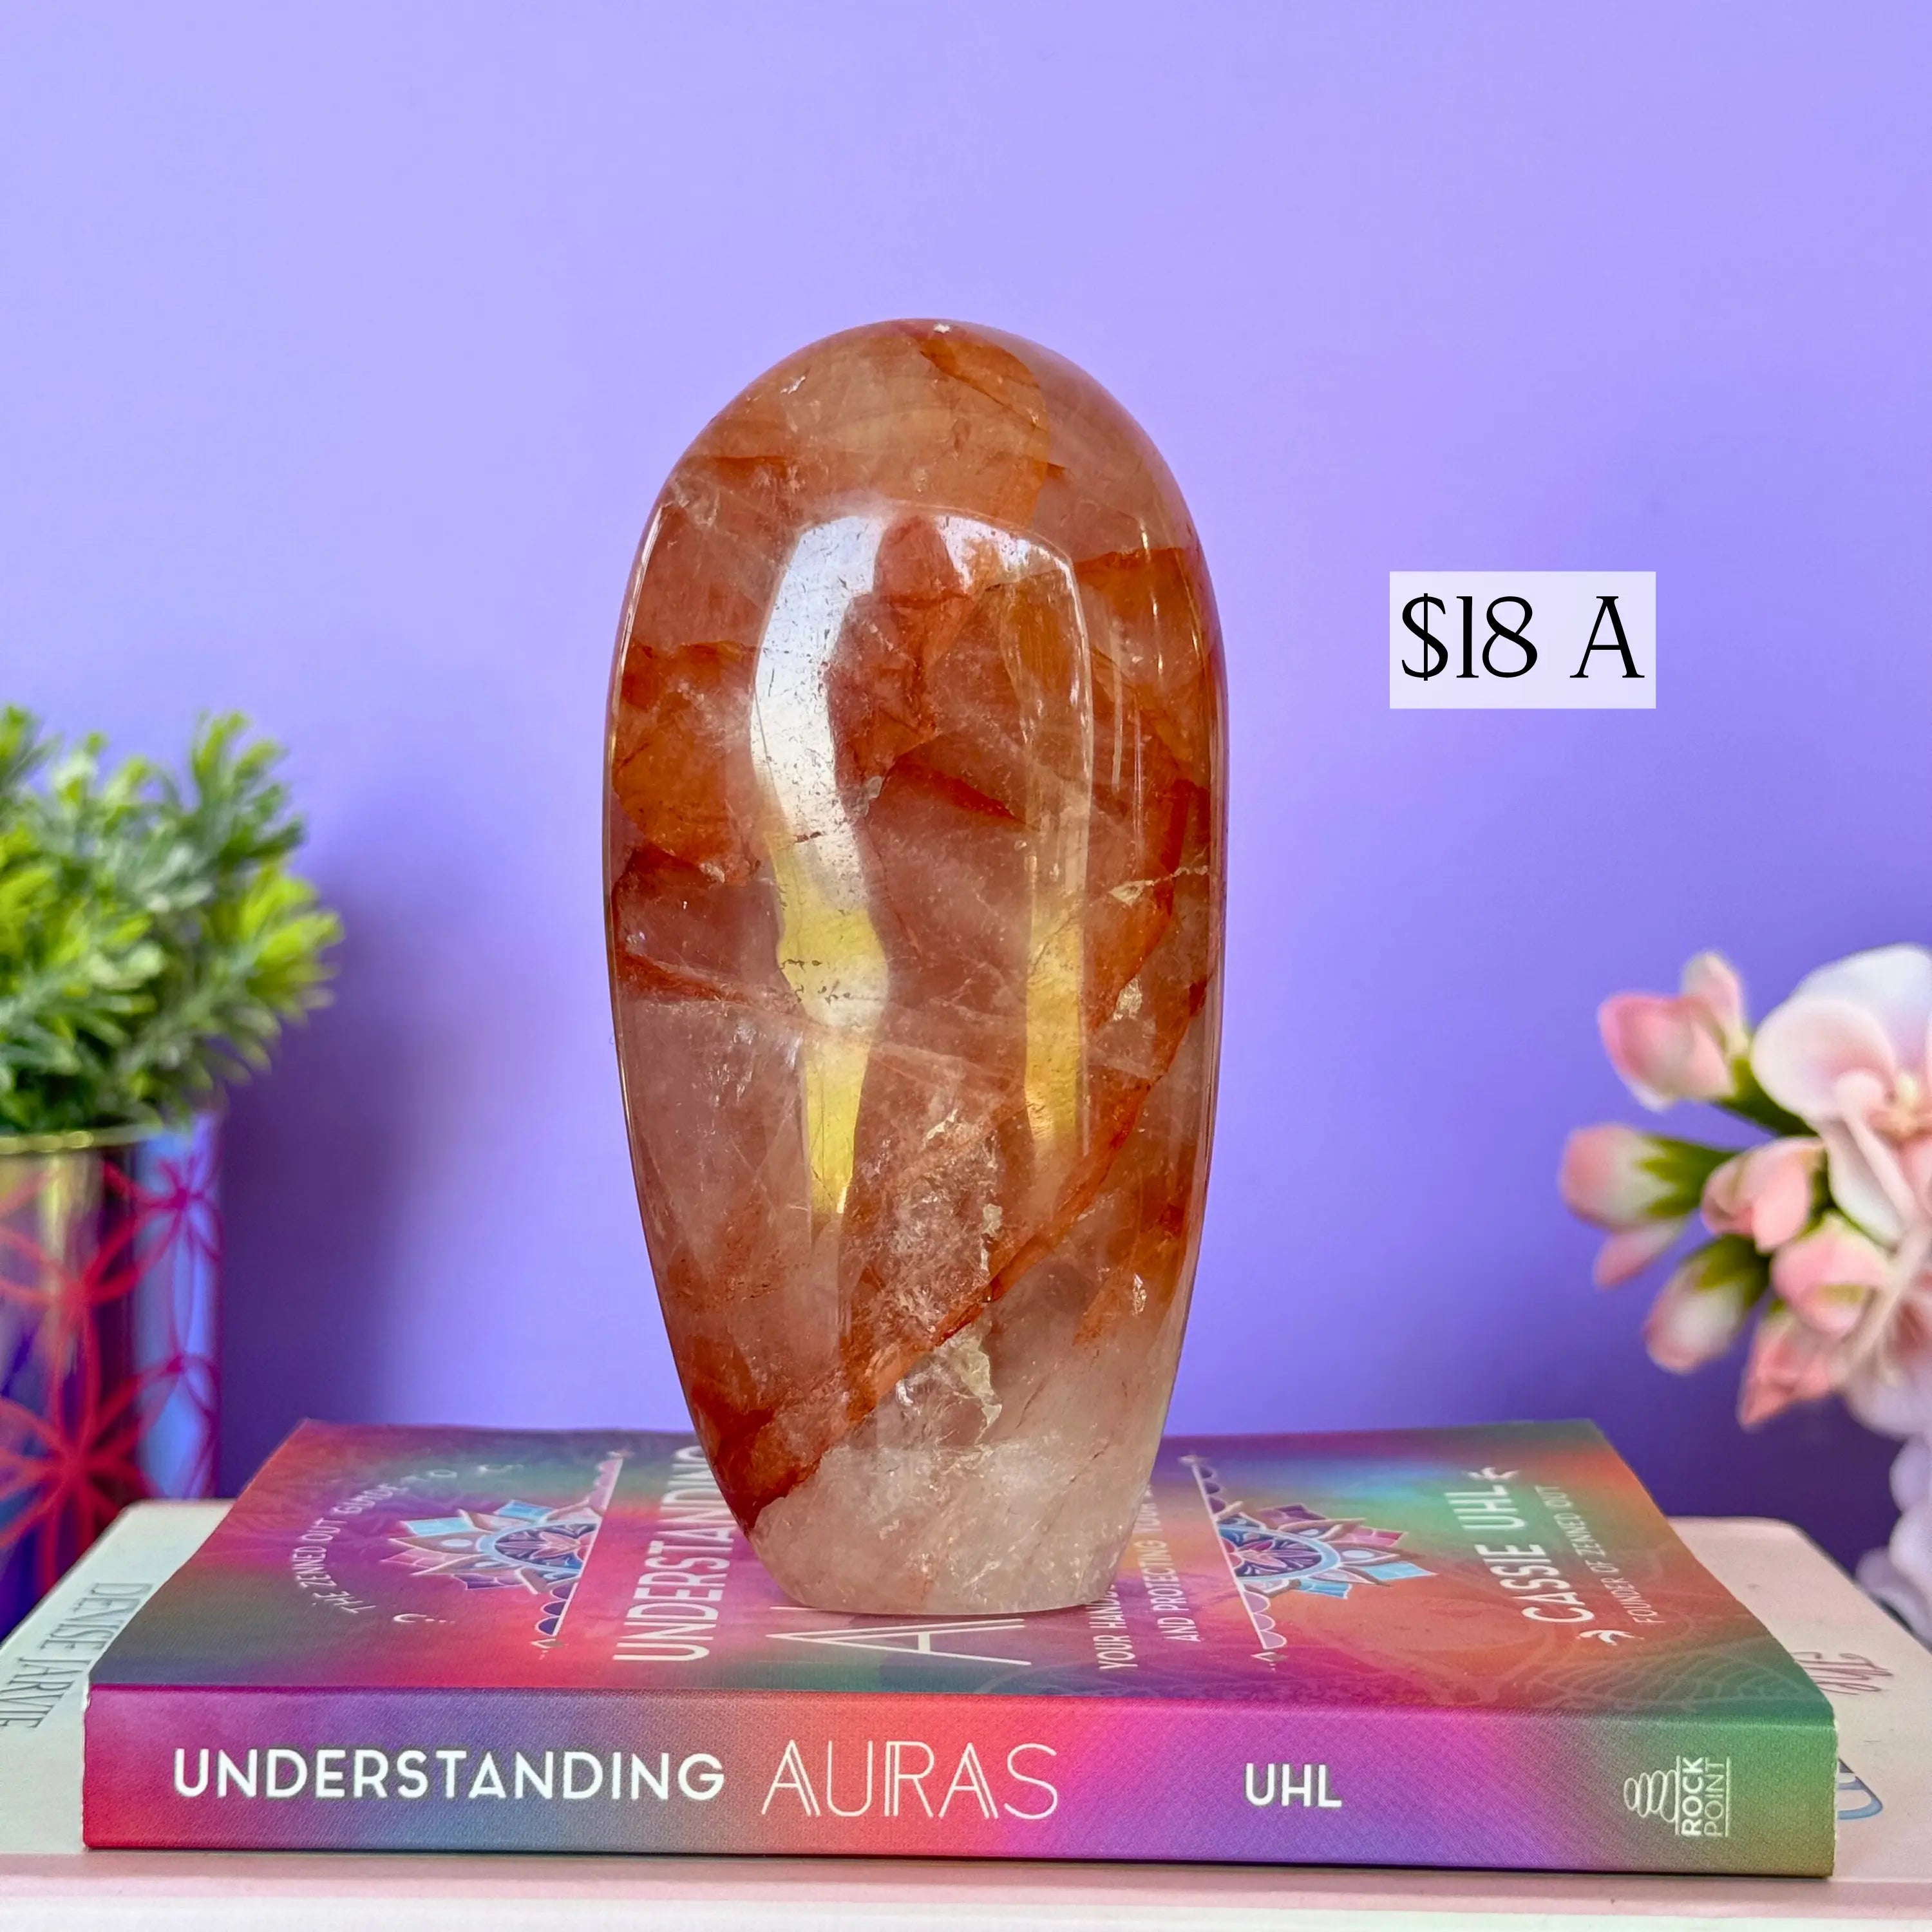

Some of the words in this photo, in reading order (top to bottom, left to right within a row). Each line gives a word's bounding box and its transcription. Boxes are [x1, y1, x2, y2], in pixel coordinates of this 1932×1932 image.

[1444, 1484, 1528, 1530] UHL
[1535, 1486, 1573, 1508] OUT
[301, 1518, 347, 1541] OUT
[1553, 1512, 1606, 1557] ZENNED
[292, 1546, 337, 1587] ZENNED
[1133, 1540, 1189, 1611] PROTECTING
[1474, 1544, 1595, 1623] CASSIE
[1585, 1560, 1620, 1574] OF
[40, 1583, 155, 1649] DENISE
[312, 1591, 376, 1613] THE
[1600, 1577, 1665, 1624] FOUNDER
[1092, 1634, 1138, 1669] YOUR
[1157, 1616, 1201, 1642] AND
[175, 1748, 724, 1801] UNDERSTANDING
[761, 1739, 1059, 1820] AURAS
[1245, 1763, 1342, 1808] UHL
[1681, 1757, 1704, 1835] ROCK
[1704, 1757, 1725, 1835] POINT
